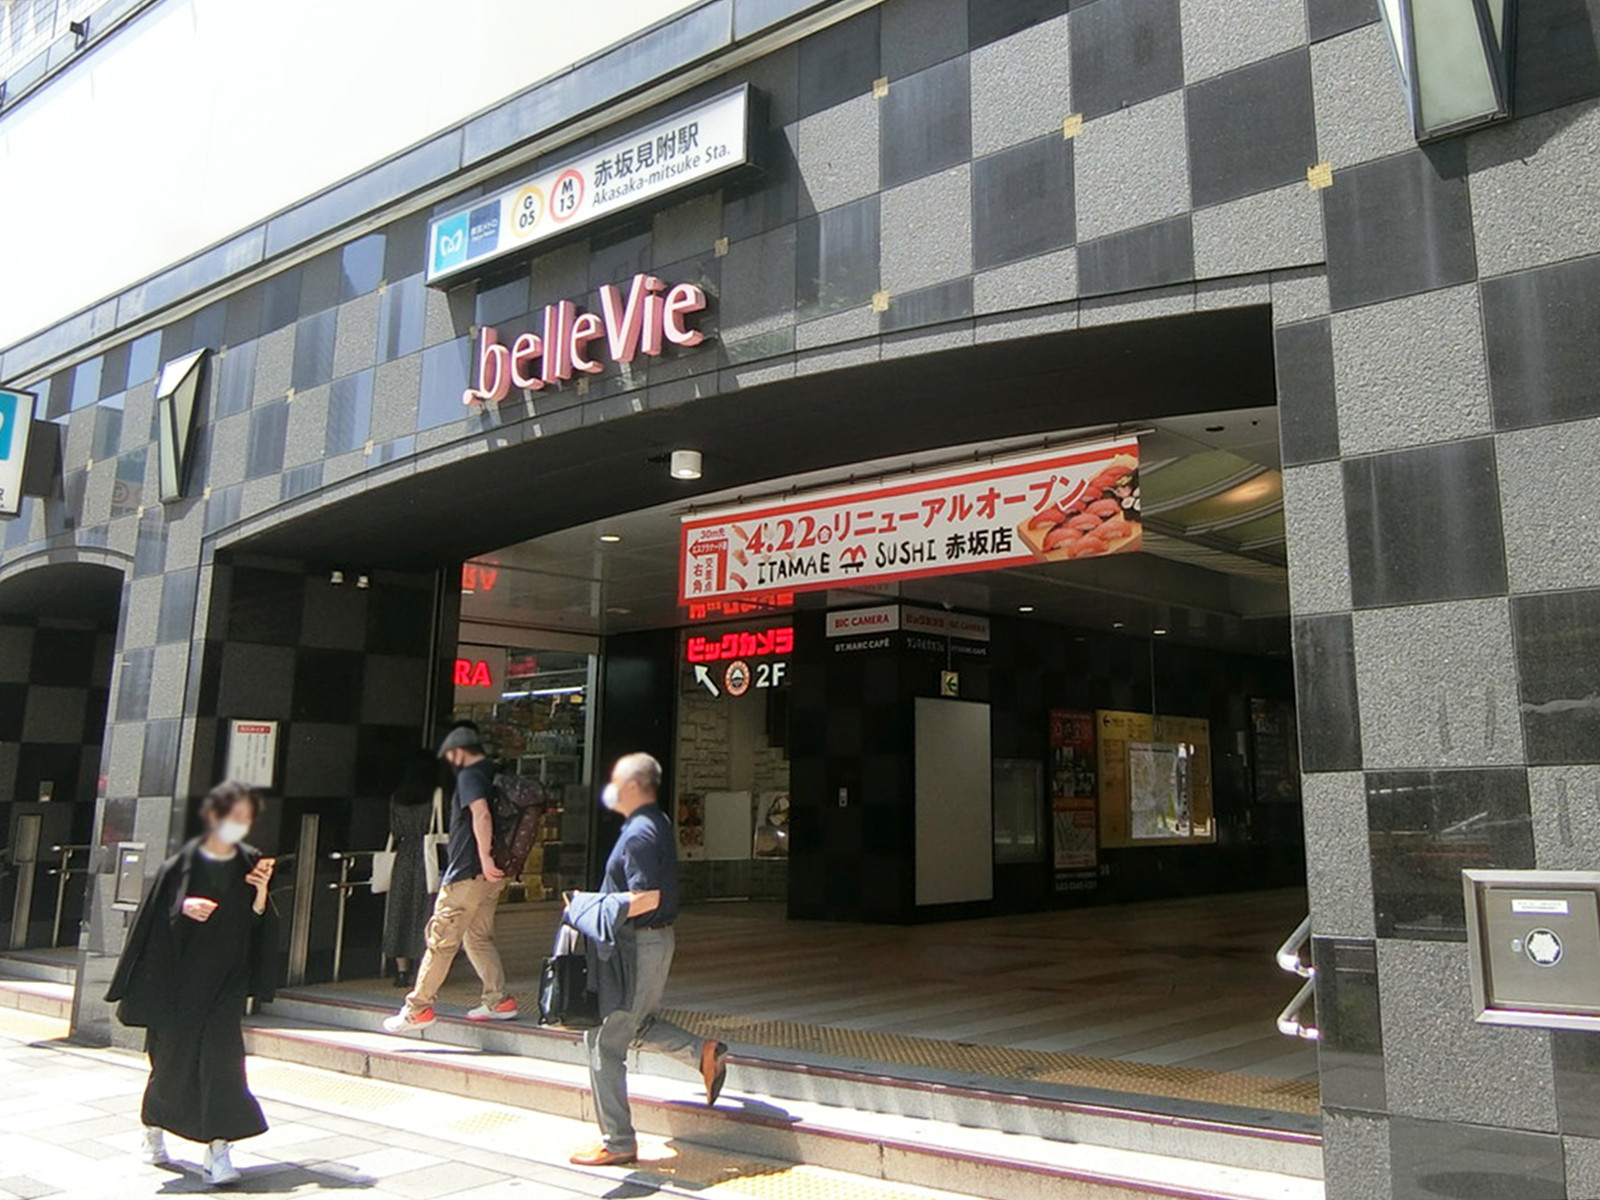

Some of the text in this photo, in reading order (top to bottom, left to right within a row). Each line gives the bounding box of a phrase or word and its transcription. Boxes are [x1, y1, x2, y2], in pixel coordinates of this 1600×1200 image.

[594, 122, 699, 188] 赤坂見附駅
[561, 179, 574, 195] M
[592, 144, 731, 207] Akasaka-mitsuke Sta.
[523, 195, 533, 210] G
[559, 194, 575, 212] 13
[519, 210, 535, 228] 05
[757, 527, 1012, 584] ITAMAE SUSHI 赤坂店
[693, 564, 703, 593] 右角
[835, 613, 890, 628] BIC CAMERA
[688, 627, 794, 662] ビックカメラ
[454, 659, 492, 688] RA
[756, 663, 786, 688] 2F
